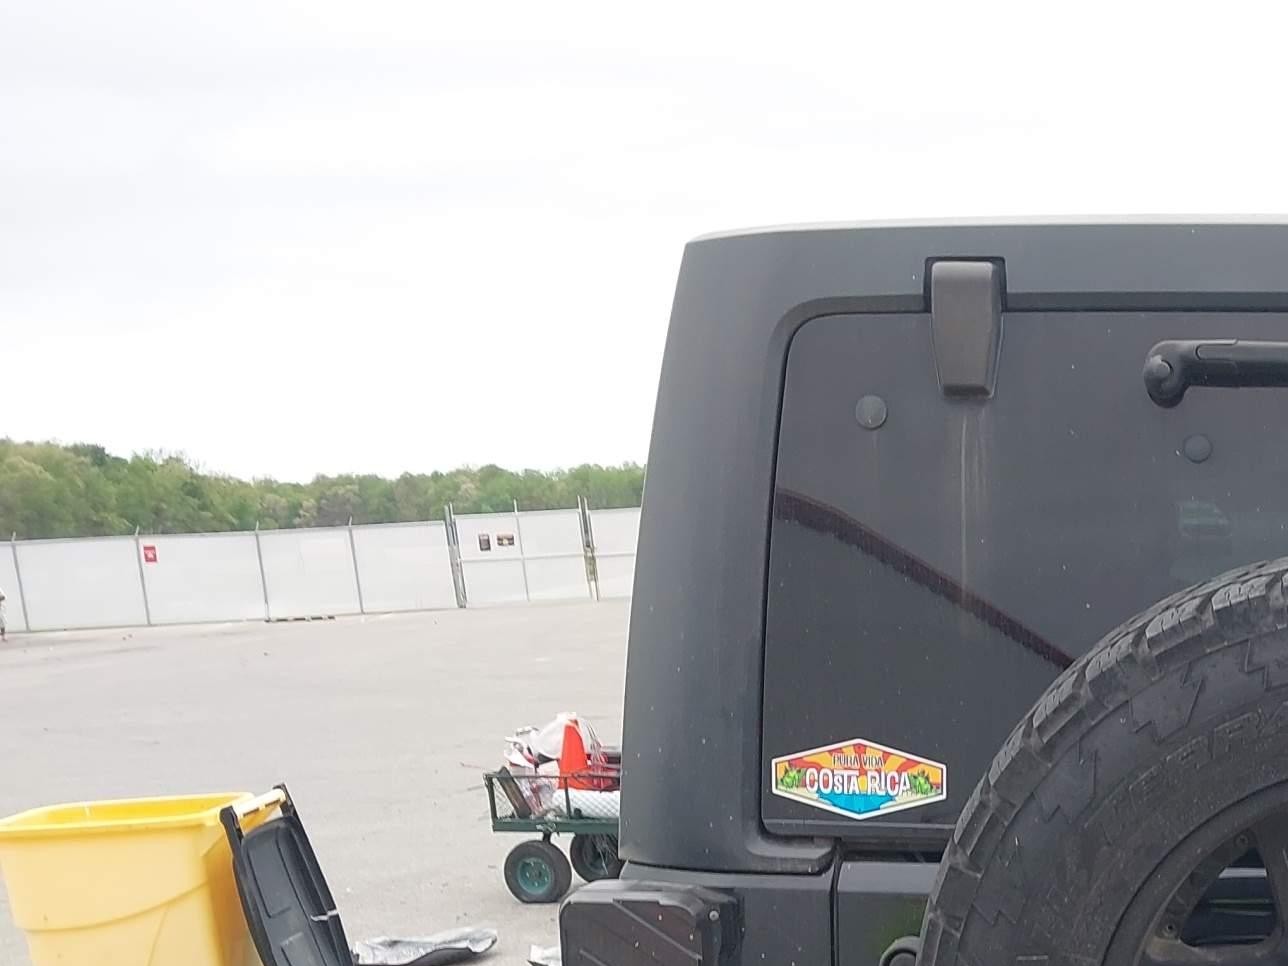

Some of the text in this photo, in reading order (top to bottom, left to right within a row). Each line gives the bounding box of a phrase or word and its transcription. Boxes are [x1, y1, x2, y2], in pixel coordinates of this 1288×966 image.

[833, 753, 885, 768] PURA VIDA
[805, 767, 912, 796] COSTA RICA
